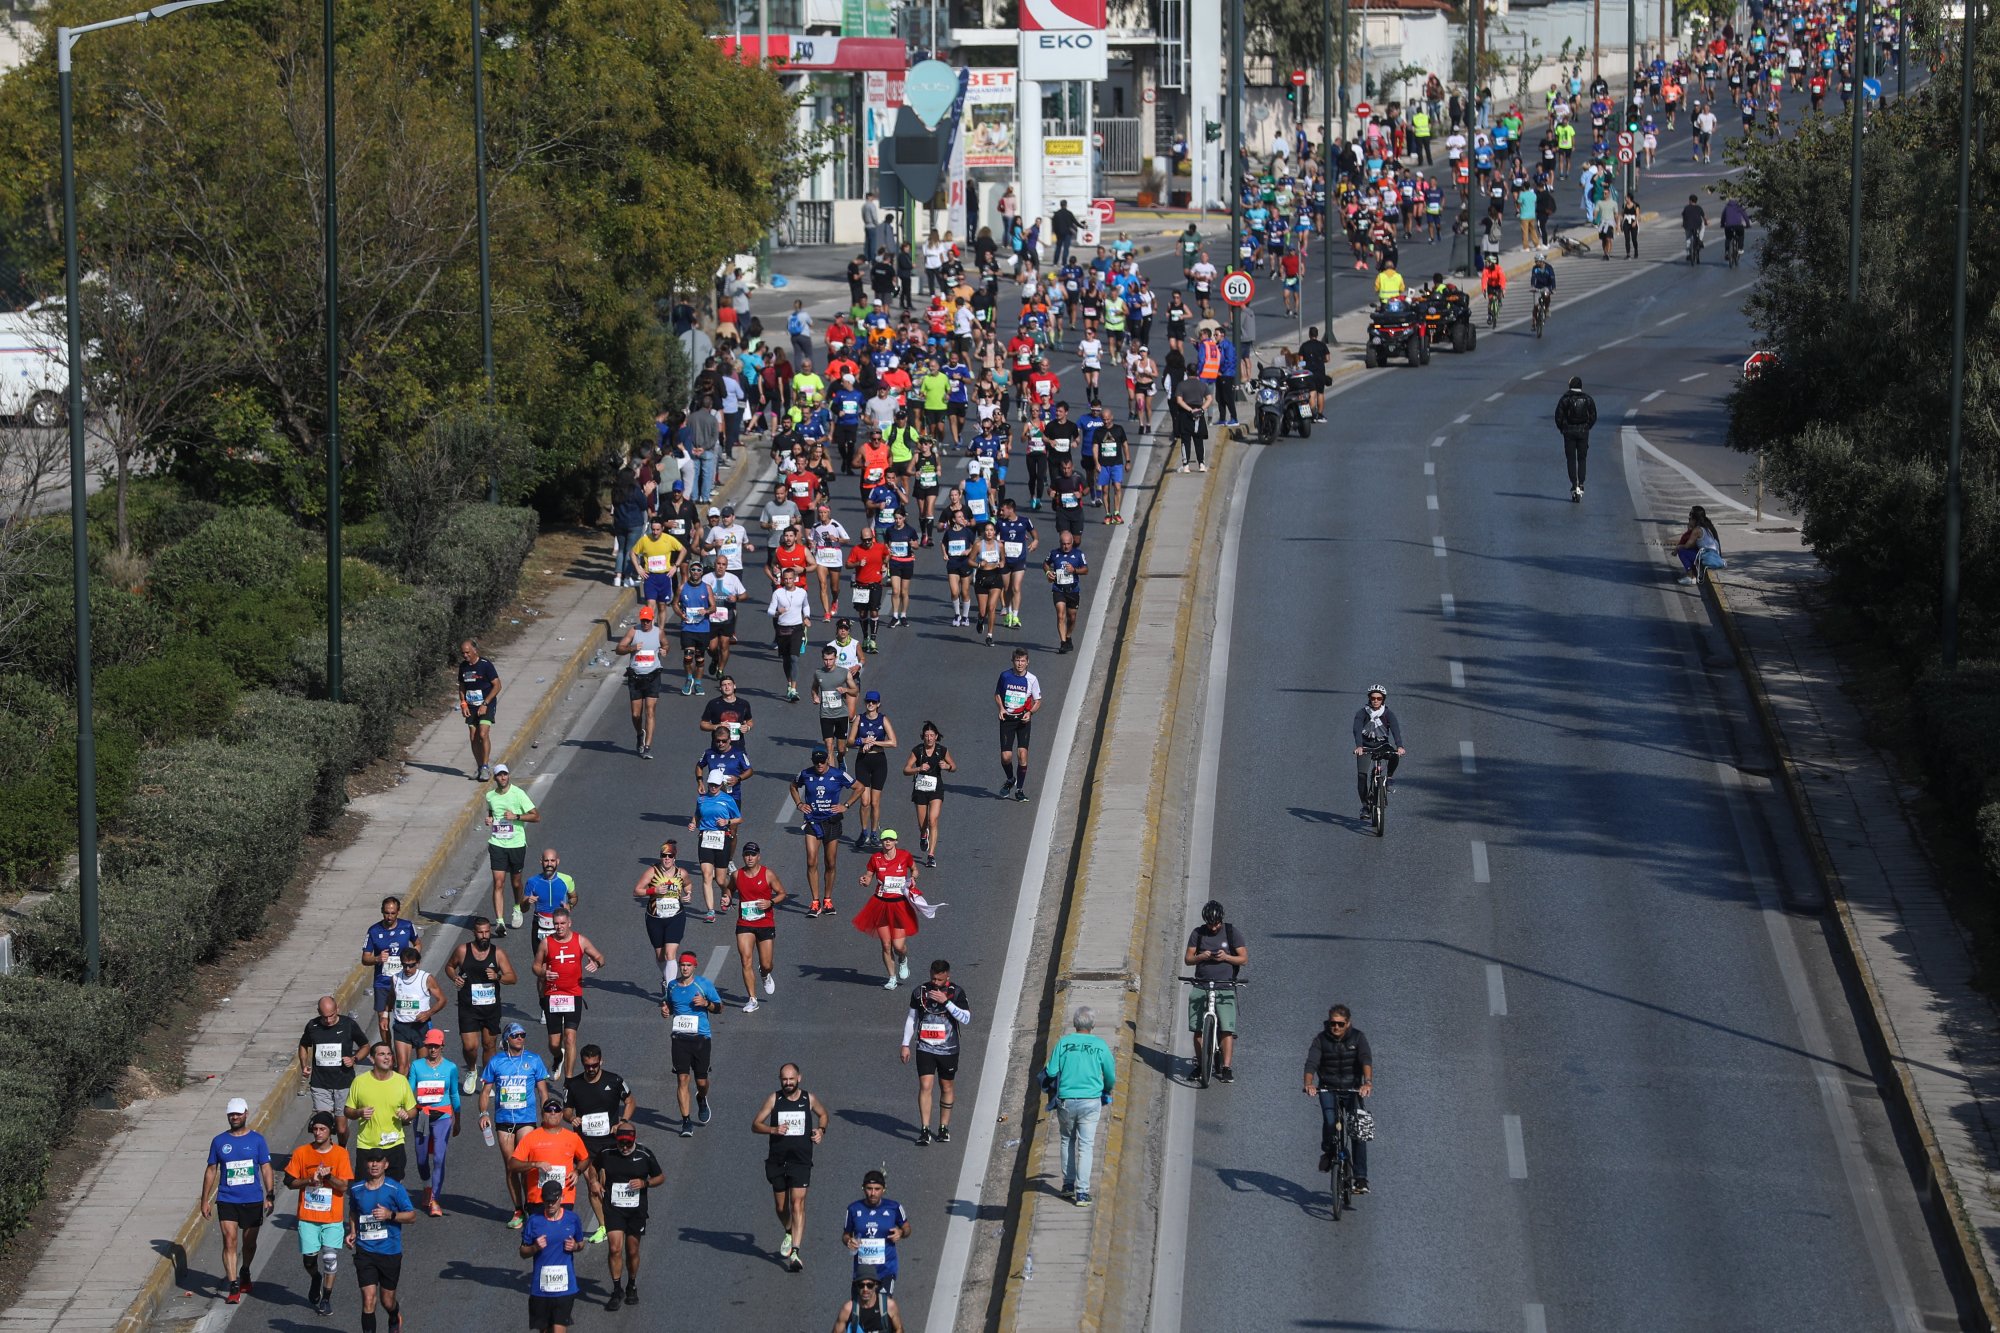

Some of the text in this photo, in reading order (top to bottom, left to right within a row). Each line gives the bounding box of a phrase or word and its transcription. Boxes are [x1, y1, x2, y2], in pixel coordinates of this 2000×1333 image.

[1040, 35, 1093, 49] EKO
[1228, 281, 1248, 296] 60
[1006, 684, 1028, 692] FRANCE
[499, 1079, 527, 1087] ITALIA
[587, 1120, 604, 1129] 16287
[233, 1168, 249, 1176] 7242
[310, 1194, 325, 1202] 9012
[863, 1247, 878, 1255] 9964
[545, 1274, 563, 1282] 11690
